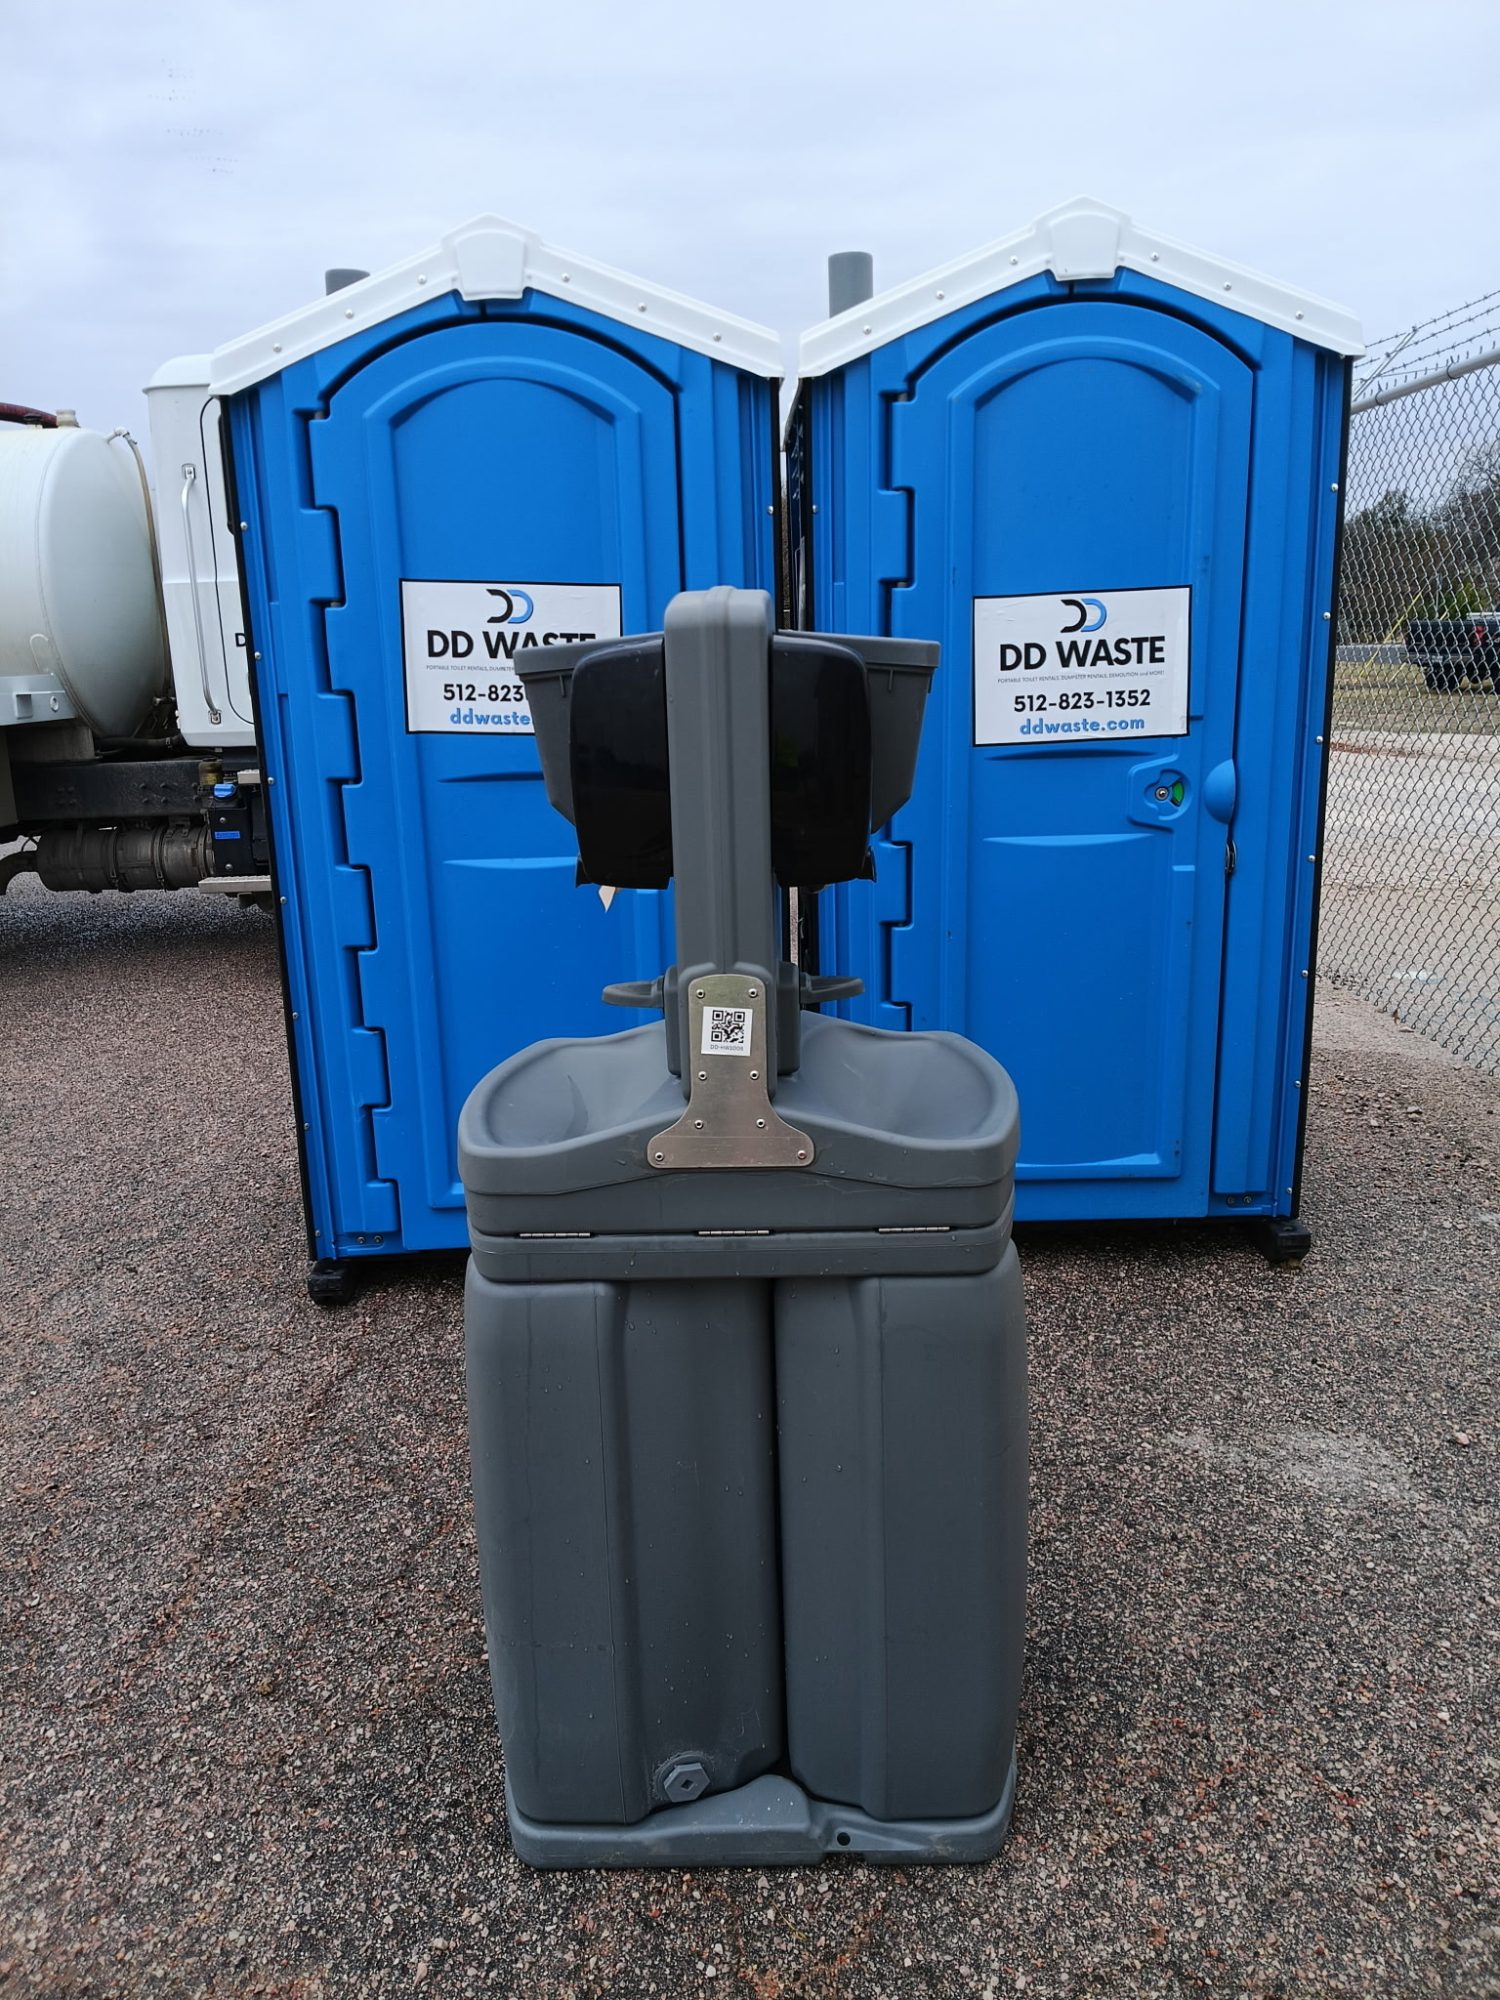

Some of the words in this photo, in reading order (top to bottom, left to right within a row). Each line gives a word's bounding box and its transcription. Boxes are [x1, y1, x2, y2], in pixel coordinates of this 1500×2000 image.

[427, 630, 474, 658] DD
[1000, 642, 1047, 671] DD
[1055, 636, 1166, 668] WASTE
[1014, 689, 1151, 712] 512-823-1352
[1020, 718, 1145, 735] ddwaste.com
